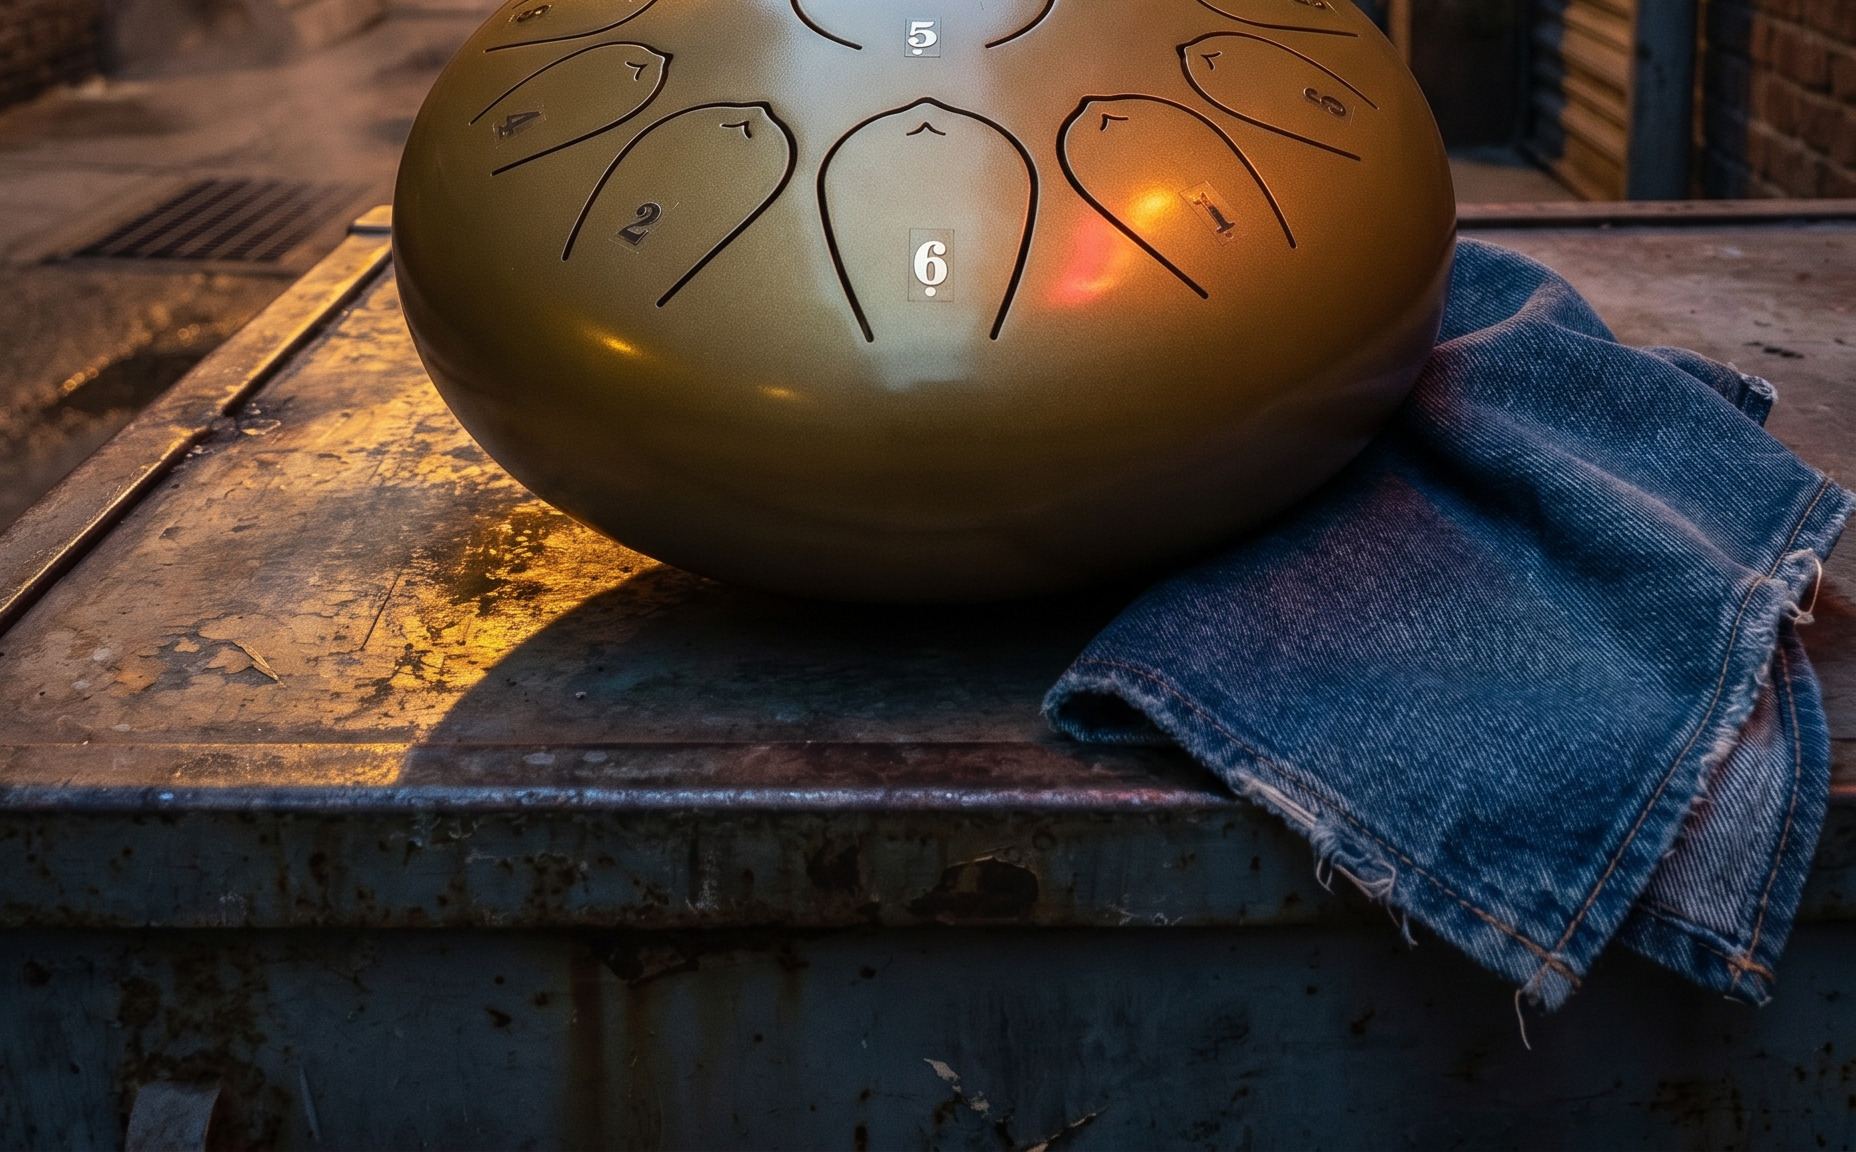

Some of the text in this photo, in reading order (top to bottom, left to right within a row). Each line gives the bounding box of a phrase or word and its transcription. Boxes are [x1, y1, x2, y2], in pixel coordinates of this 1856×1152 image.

[907, 21, 938, 48] 5
[617, 202, 662, 246] 2
[1193, 192, 1235, 234] 1
[913, 240, 948, 286] 6
